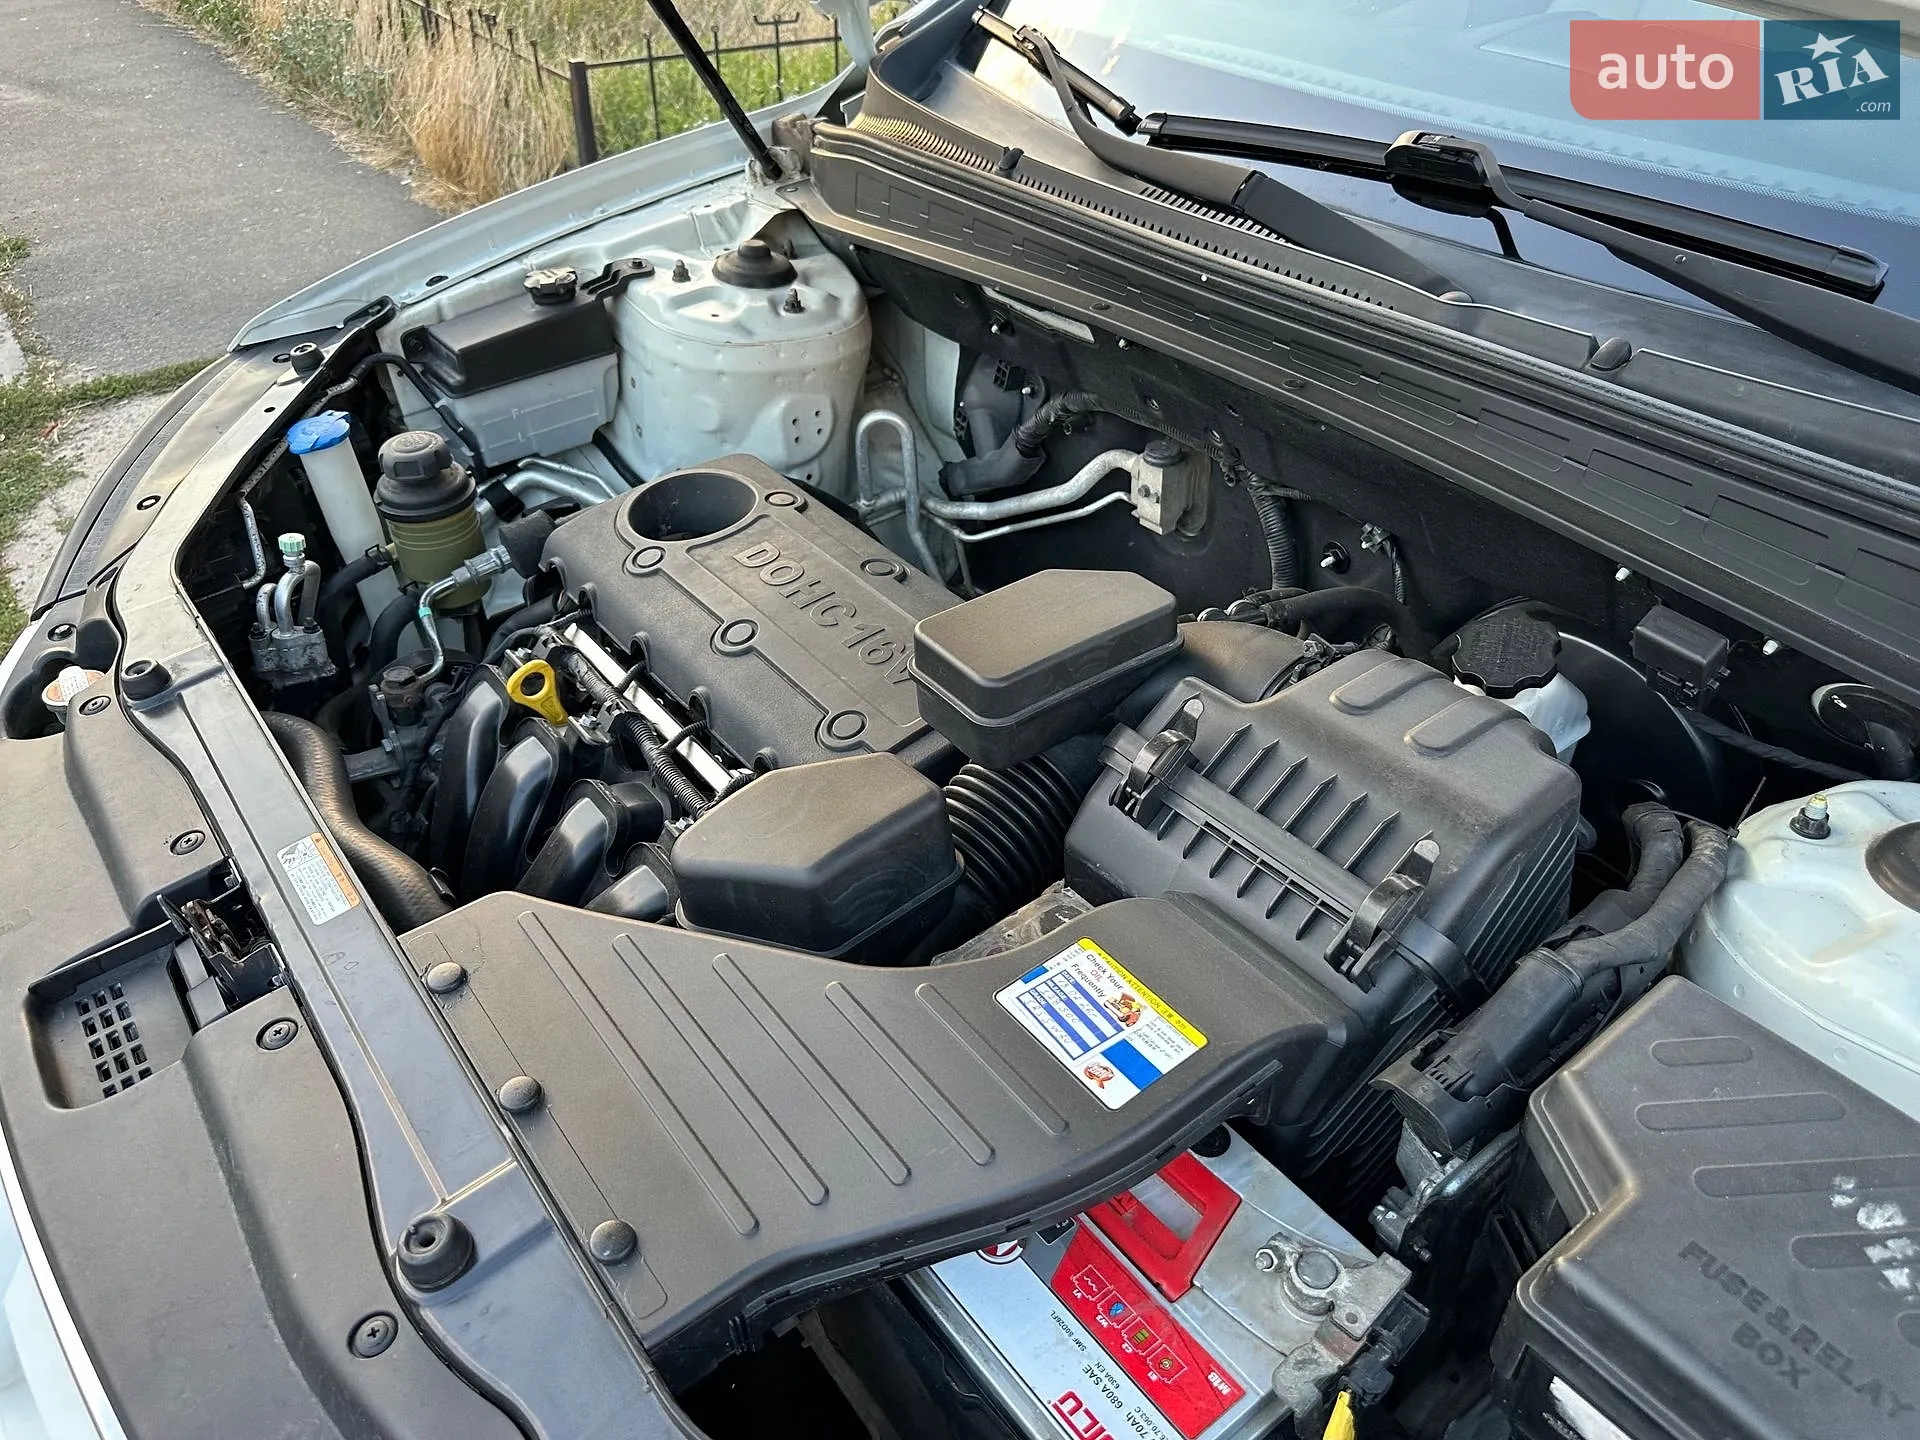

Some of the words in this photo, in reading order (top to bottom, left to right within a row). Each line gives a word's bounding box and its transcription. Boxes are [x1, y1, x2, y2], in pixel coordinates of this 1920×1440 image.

[733, 541, 856, 626] DOHC
[841, 625, 911, 684] 16V
[1070, 963, 1105, 997] Frequently
[1085, 953, 1107, 974] Check
[1106, 973, 1123, 990] Your
[1089, 969, 1102, 982] OIL
[1125, 980, 1160, 1008] ATTENTION
[1072, 1337, 1087, 1351] SMF
[1731, 1322, 1810, 1389] BOX
[1082, 1364, 1102, 1385] SAE
[1095, 1361, 1105, 1373] EN
[1101, 1384, 1123, 1409] 680A
[1126, 1412, 1148, 1439] 70Ah
